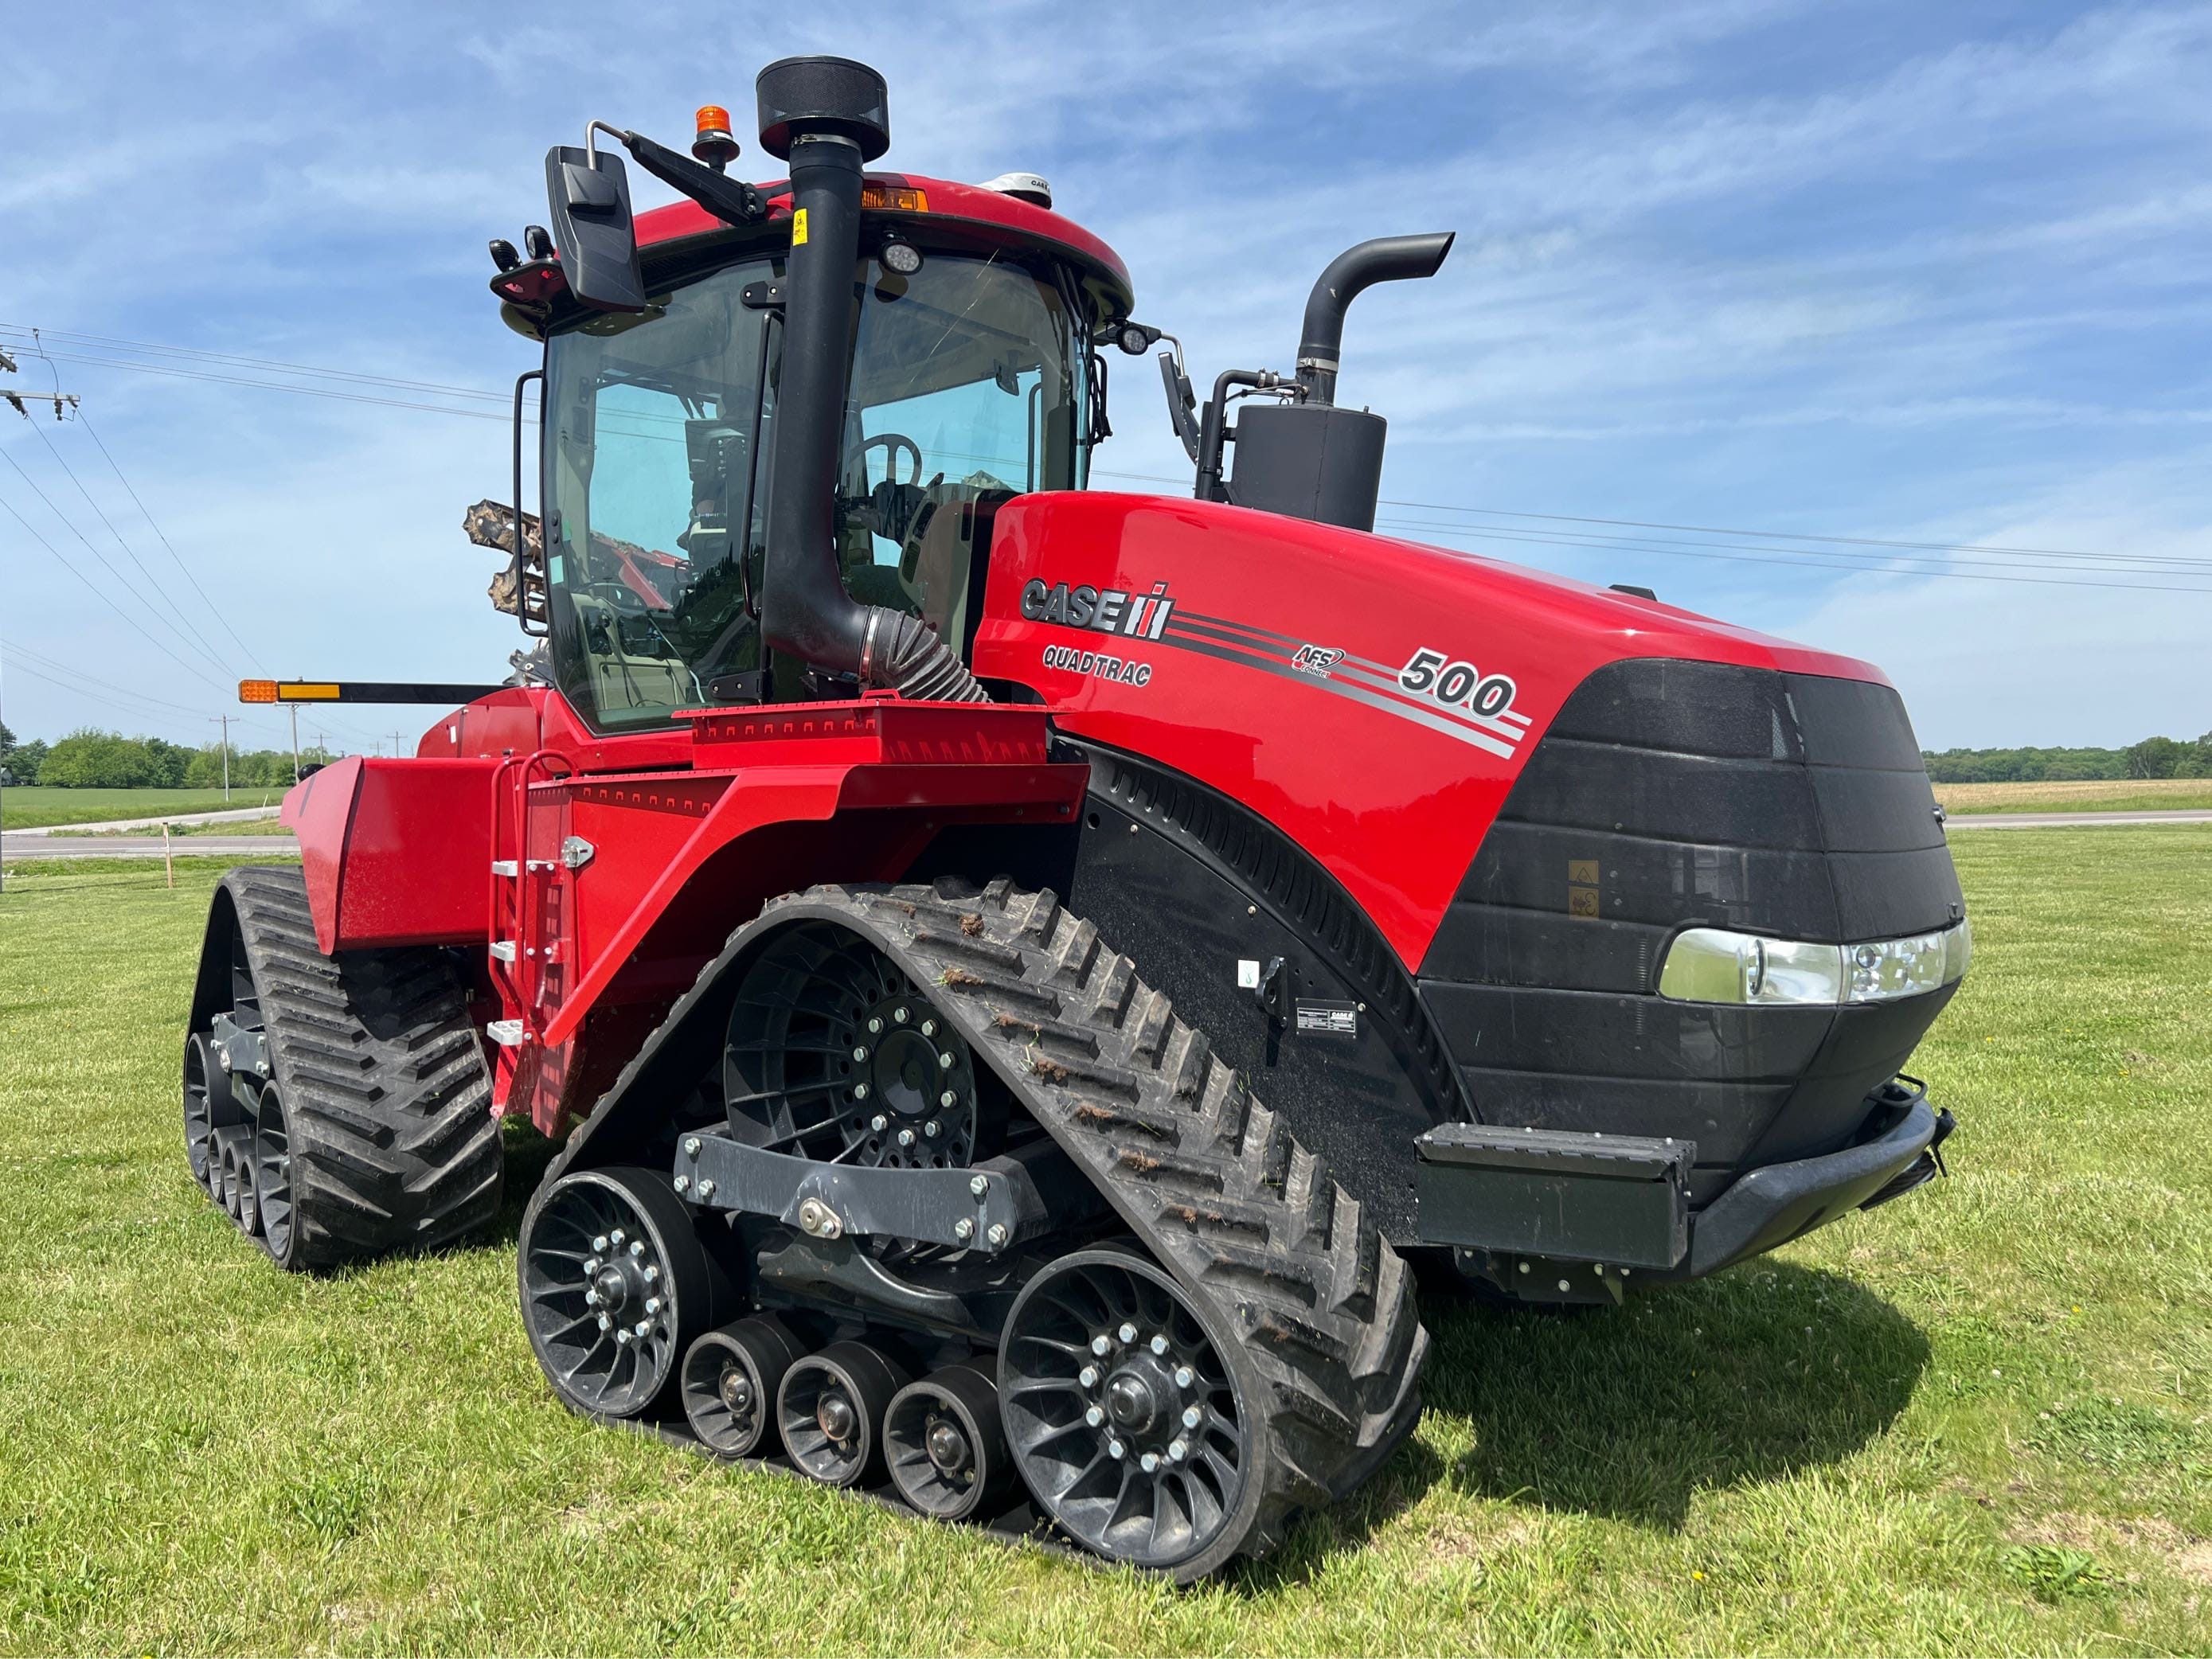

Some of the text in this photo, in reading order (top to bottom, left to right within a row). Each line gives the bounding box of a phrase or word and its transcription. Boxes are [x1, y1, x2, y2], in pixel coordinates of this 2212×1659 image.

[1020, 578, 1127, 632] CASE
[1043, 645, 1151, 687] QUADTRAC
[1292, 644, 1335, 668] AFS
[1300, 664, 1331, 679] CONNECT
[1398, 646, 1516, 720] 500
